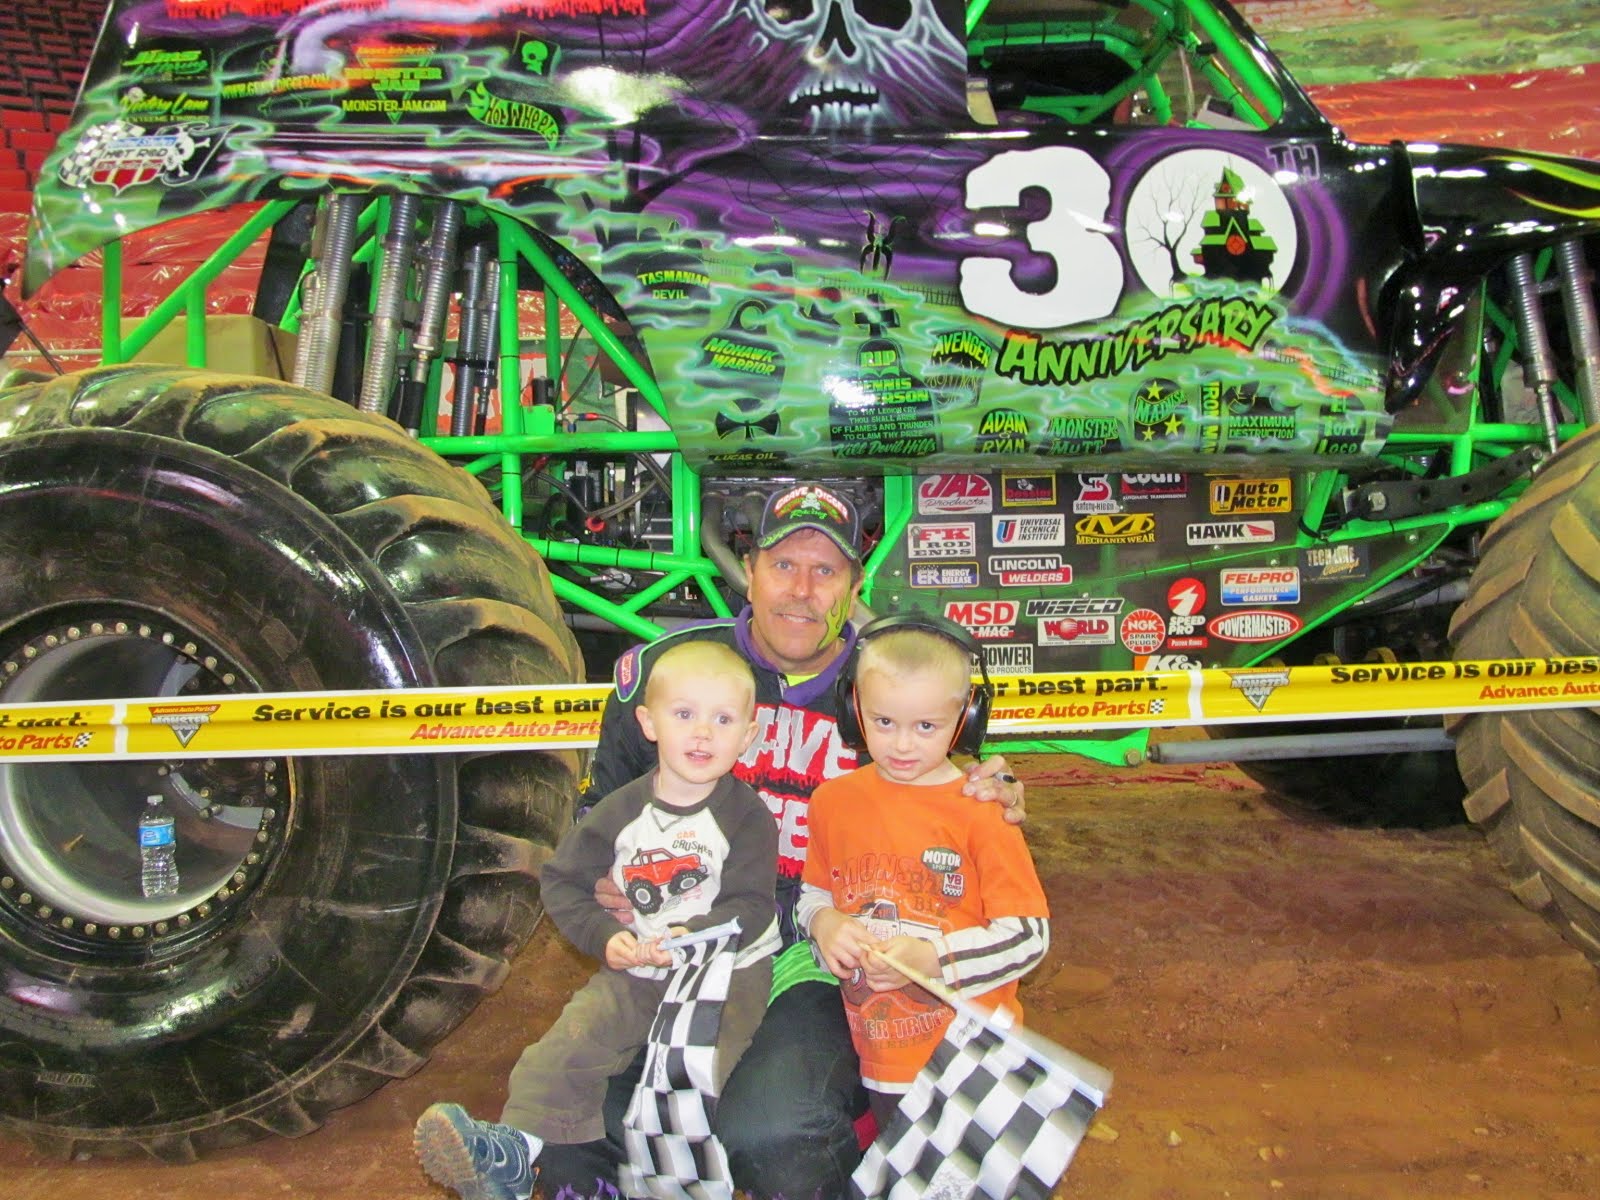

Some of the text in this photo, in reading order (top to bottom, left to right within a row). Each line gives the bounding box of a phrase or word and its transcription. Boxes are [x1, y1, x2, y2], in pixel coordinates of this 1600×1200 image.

[344, 67, 442, 80] MONSTER
[371, 79, 420, 92] JAM
[342, 99, 447, 113] MONSTERJAM.COM
[636, 269, 711, 289] TASMANIAN
[651, 288, 690, 300] DEVIL
[998, 297, 1277, 384] ANNIVERSARY
[703, 337, 780, 362] MOHAWK
[932, 331, 993, 368] AVENGER
[710, 352, 776, 376] WARRIOR
[859, 349, 898, 367] RIP
[853, 377, 912, 391] ENNIS
[1202, 381, 1221, 417] IRON
[871, 415, 895, 424] SHALL
[981, 410, 1028, 436] ADAM
[1229, 415, 1296, 428] MAXIMUM
[831, 420, 934, 434] OF FLAMES AND THUNDER
[1051, 416, 1119, 439] MONSTER
[1229, 428, 1295, 439] DESTRUCTION
[842, 433, 855, 441] TO
[856, 432, 882, 441] CLAIM
[981, 438, 1026, 454] RYAN
[714, 452, 778, 461] LUCAS OIL
[921, 474, 991, 498] JAZ
[1233, 482, 1280, 496] Auto
[1230, 495, 1288, 512] Meter
[1019, 525, 1060, 533] TECHNICAL
[1020, 518, 1061, 526] UNIVERSAL
[918, 527, 971, 541] FK
[1018, 532, 1058, 541] INSTITUTE
[1188, 524, 1246, 539] HAWK
[926, 540, 972, 549] ROD
[1076, 533, 1155, 545] MECHANIX WEAR
[913, 548, 972, 557] ENDS
[994, 558, 1057, 571] LINCOLN
[941, 568, 971, 577] ENERGY
[1008, 572, 1064, 583] WELDERS
[1224, 572, 1294, 585] FEL-PRO
[941, 576, 973, 585] RELEASE
[1230, 586, 1290, 595] PERFORMANCE
[1242, 594, 1278, 602] GASKETS
[948, 602, 1015, 625] MSD
[1169, 615, 1206, 626] SPEED
[1043, 618, 1109, 640] WORLD
[1127, 619, 1158, 631] NGK
[1167, 625, 1194, 636] PRO
[1217, 614, 1292, 638] POWERMASTER
[1129, 639, 1158, 647] PLUGS
[996, 665, 1032, 674] PRODUCTS
[1330, 657, 1600, 684] Service is our bes
[1017, 677, 1087, 697] best
[1095, 677, 1168, 697] part.
[1231, 677, 1289, 688] MONSTER
[1243, 687, 1273, 696] JAM
[1478, 685, 1559, 700] Advance
[252, 696, 605, 722] Service is our best par
[990, 700, 1145, 720] ance Auto Parts
[410, 723, 496, 740] Advance
[497, 721, 551, 738] Auto
[18, 733, 73, 750] Parts
[738, 706, 857, 780] AVE
[676, 830, 696, 839] CAR
[672, 839, 713, 858] CRUSHER
[922, 850, 962, 867] MOTOR
